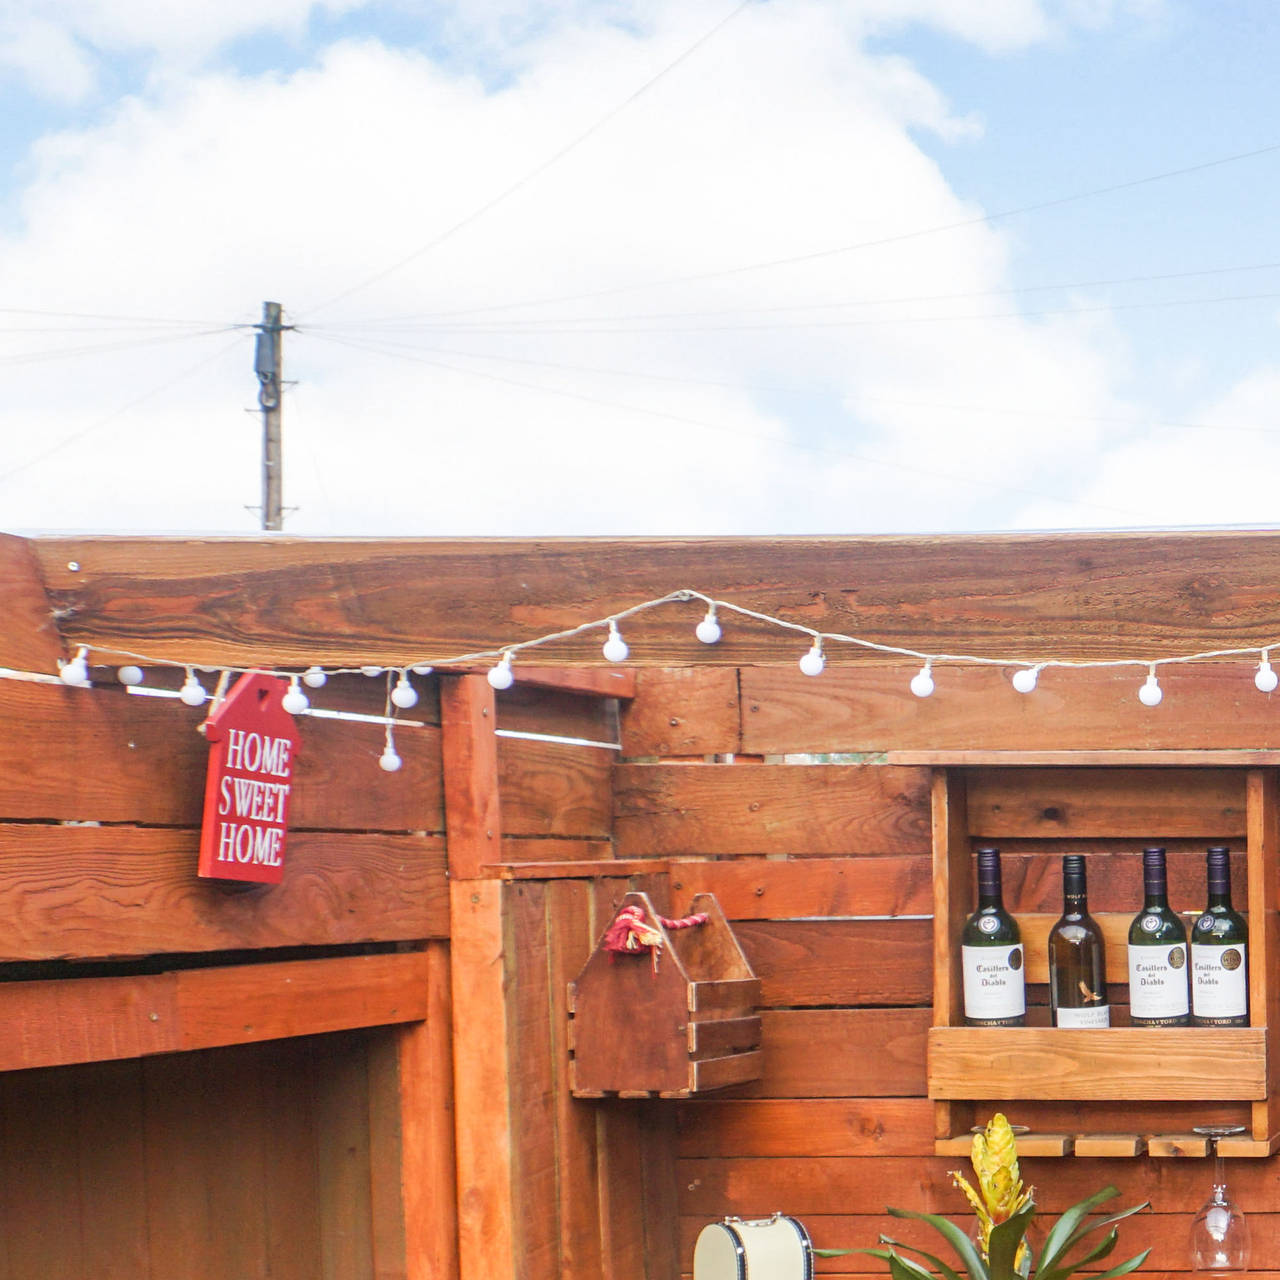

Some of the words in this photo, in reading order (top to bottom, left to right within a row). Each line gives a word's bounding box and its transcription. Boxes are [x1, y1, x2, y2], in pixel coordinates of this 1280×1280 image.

[225, 729, 292, 777] HOME
[218, 775, 290, 823] SWEET
[217, 822, 284, 867] HOME
[1135, 964, 1168, 972] Casillero
[1140, 977, 1165, 986] Diablo
